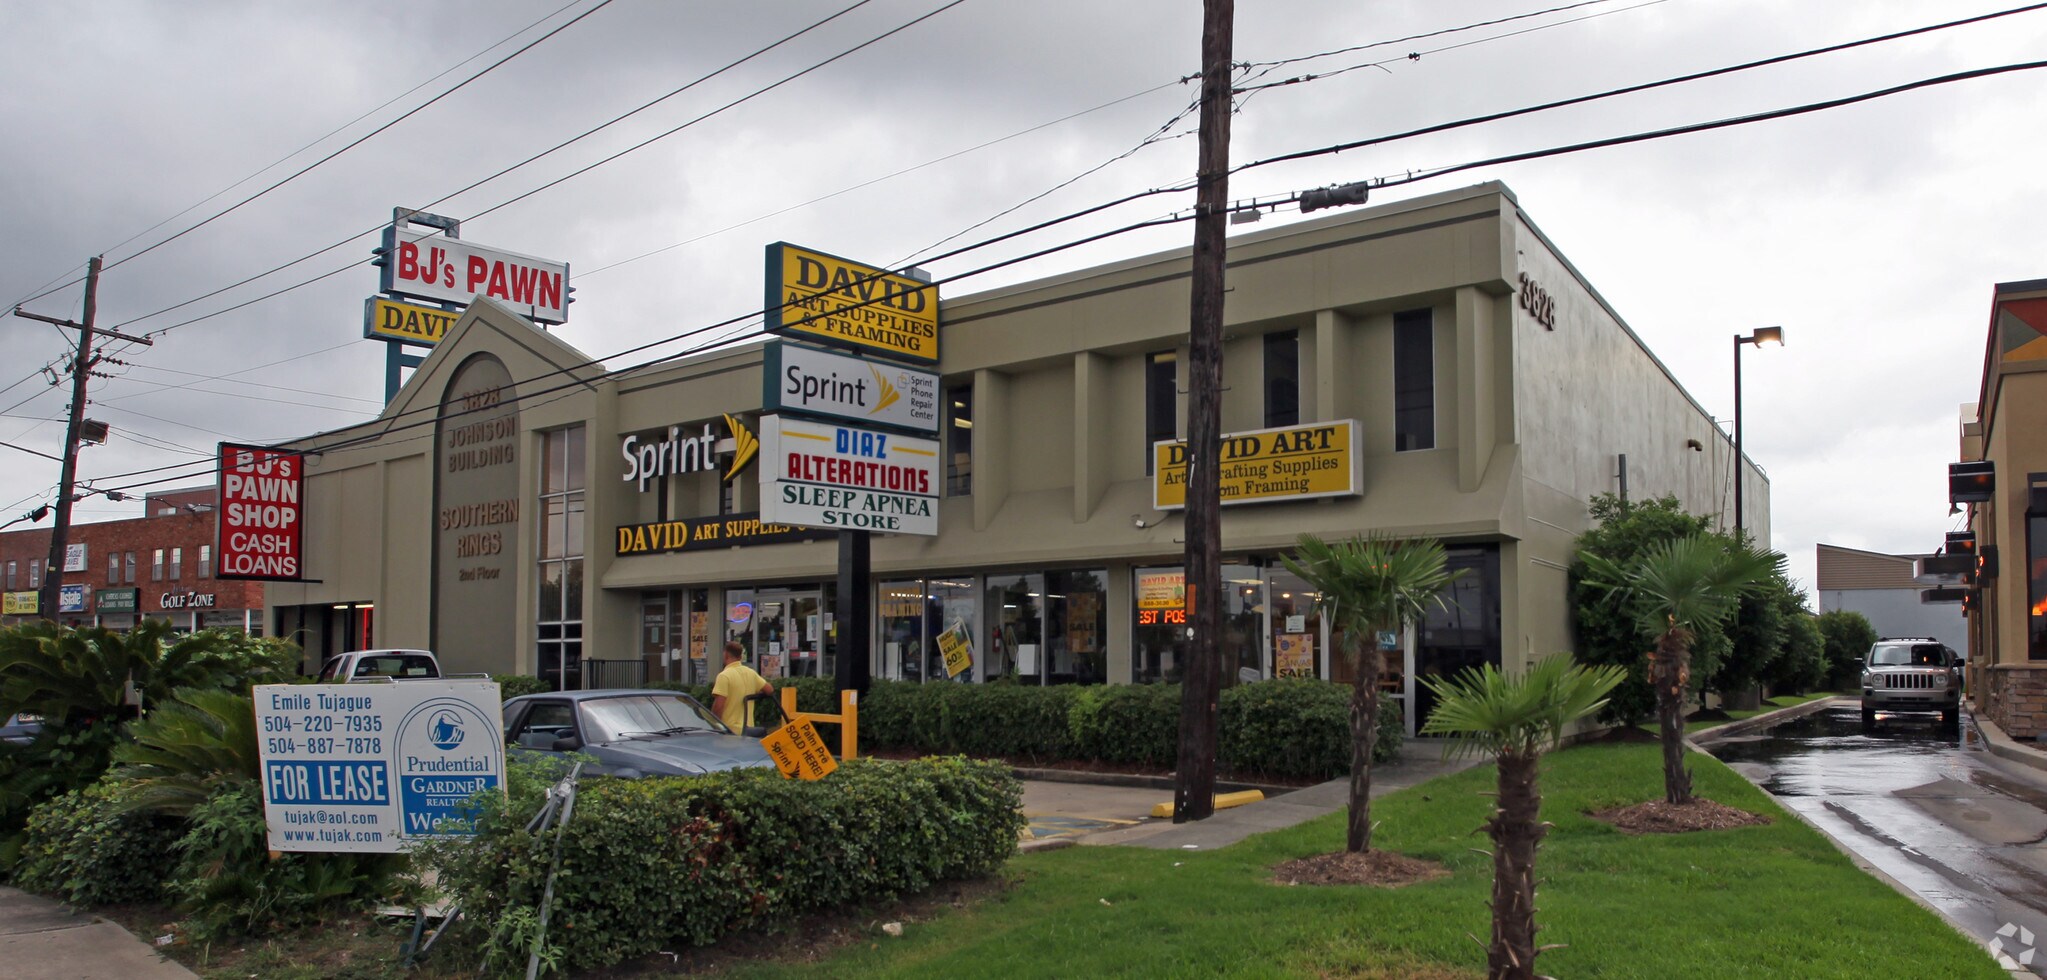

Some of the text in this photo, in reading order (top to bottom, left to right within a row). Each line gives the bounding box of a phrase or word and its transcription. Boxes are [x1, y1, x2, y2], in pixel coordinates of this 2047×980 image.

[399, 240, 562, 311] BJ's PAWN
[796, 255, 926, 313] DAVID
[787, 291, 934, 338] ART SUPPLIES
[1519, 271, 1556, 331] 3828
[382, 305, 457, 337] DAVI
[801, 311, 921, 351] & FRAMING
[786, 365, 866, 406] Sprint
[911, 375, 933, 388] Sprint
[911, 386, 933, 399] Phone
[911, 397, 933, 410] Repair
[911, 409, 934, 420] Center
[448, 416, 515, 448] JOHNSON
[836, 428, 887, 459] DIAZ
[1270, 427, 1335, 454] ART
[236, 450, 292, 477] BJ's
[448, 443, 514, 473] BUILDING
[622, 423, 715, 492] Sprint
[1164, 471, 1187, 485] Art
[1272, 456, 1338, 477] Supplies
[788, 453, 929, 493] ALTERATIONS
[1245, 477, 1310, 494] Framing
[226, 473, 297, 503] PAWN
[783, 485, 931, 517] SLEEP APNEA
[228, 503, 296, 529] SHOP
[440, 499, 519, 531] SOUTHERN
[822, 510, 900, 530] STORE
[230, 532, 290, 554] CASH
[457, 530, 502, 558] RINGS
[618, 521, 688, 552] DAVID
[693, 523, 720, 541] ART
[224, 554, 297, 576] LOANS
[459, 566, 501, 581] 2nd Floor
[60, 591, 81, 606] llstate
[160, 591, 214, 608] GOLF ZONE
[272, 693, 372, 712] Emile Tujague
[265, 715, 382, 732] 504-220-7935
[801, 723, 818, 747] Palm
[268, 738, 381, 754] 504-887-7878
[771, 741, 792, 767] Sprint
[786, 725, 824, 778] SOLD HERE!
[407, 756, 489, 772] Prudential
[270, 765, 386, 801] FOR LEASE
[411, 777, 487, 794] GARDNER
[284, 810, 378, 826] tujak@aol.com
[284, 828, 382, 844] www.tujak.com
